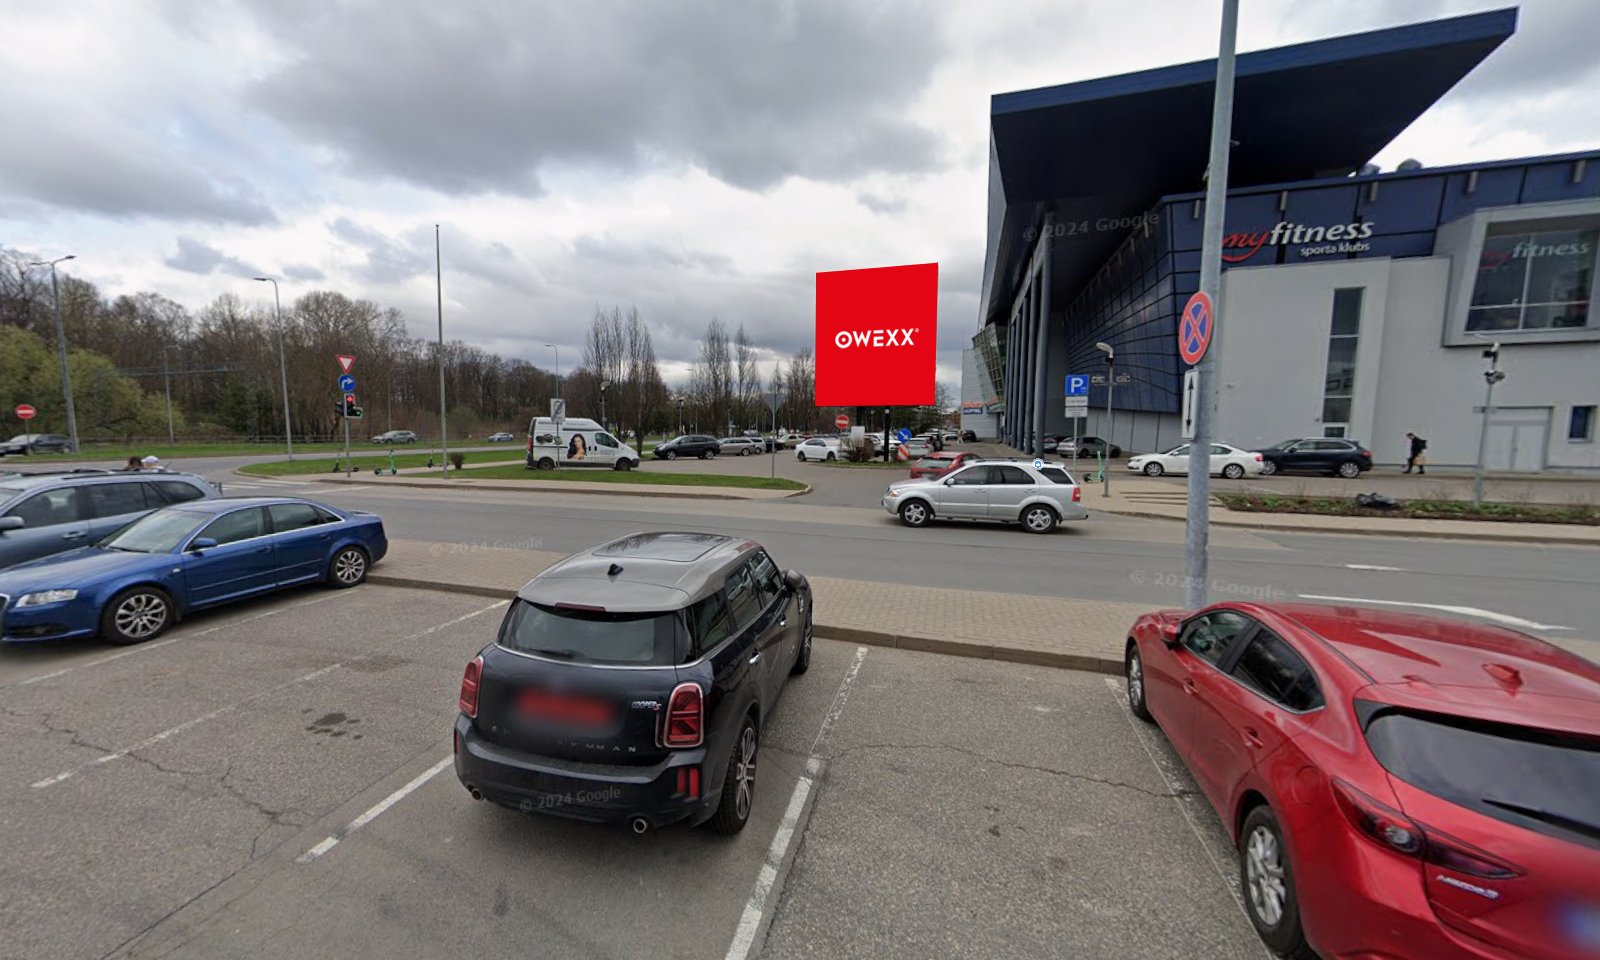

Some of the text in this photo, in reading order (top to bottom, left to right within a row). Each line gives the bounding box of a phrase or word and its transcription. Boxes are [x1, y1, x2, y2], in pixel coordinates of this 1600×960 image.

[1301, 241, 1371, 257] sporta klubs
[1480, 241, 1590, 270] fitness
[1070, 377, 1084, 394] P
